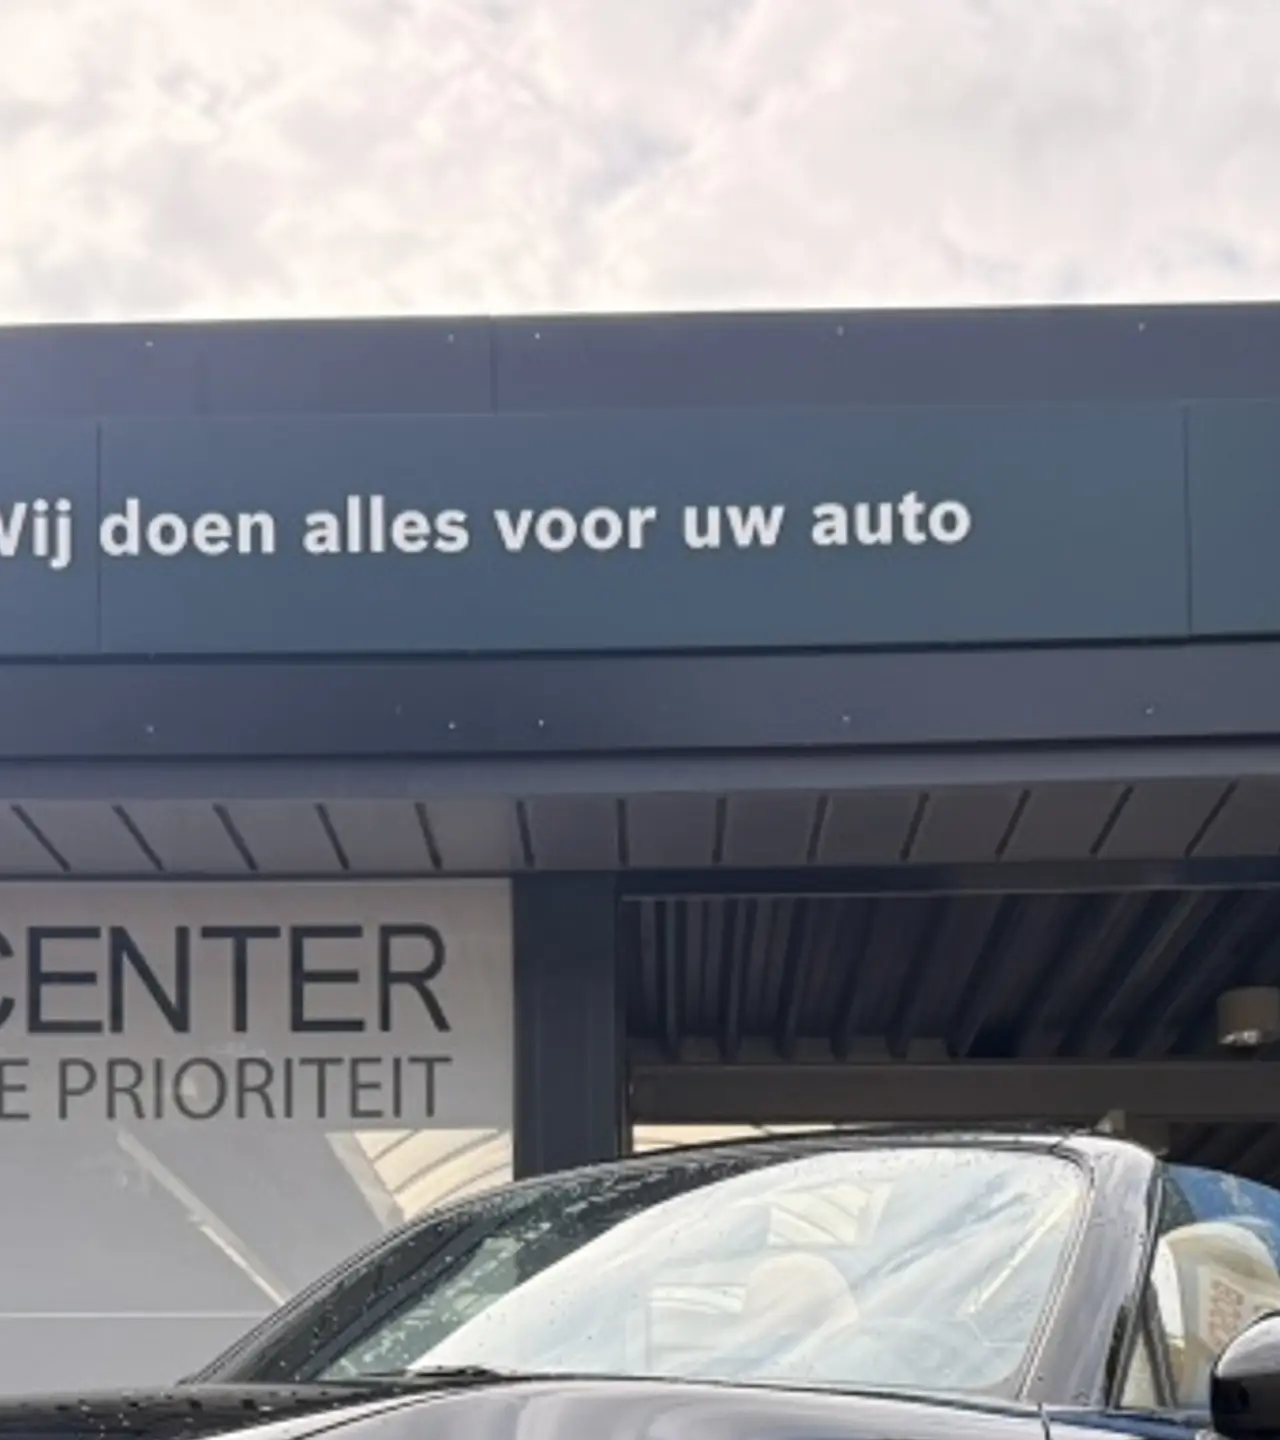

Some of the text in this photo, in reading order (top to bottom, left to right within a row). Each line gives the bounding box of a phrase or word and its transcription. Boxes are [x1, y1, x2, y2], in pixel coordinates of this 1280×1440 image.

[100, 498, 275, 556] doen
[303, 494, 469, 554] alles
[493, 506, 657, 551] voor
[683, 505, 784, 549] uw
[811, 491, 971, 545] auto
[58, 1056, 453, 1121] PRIORITEIT
